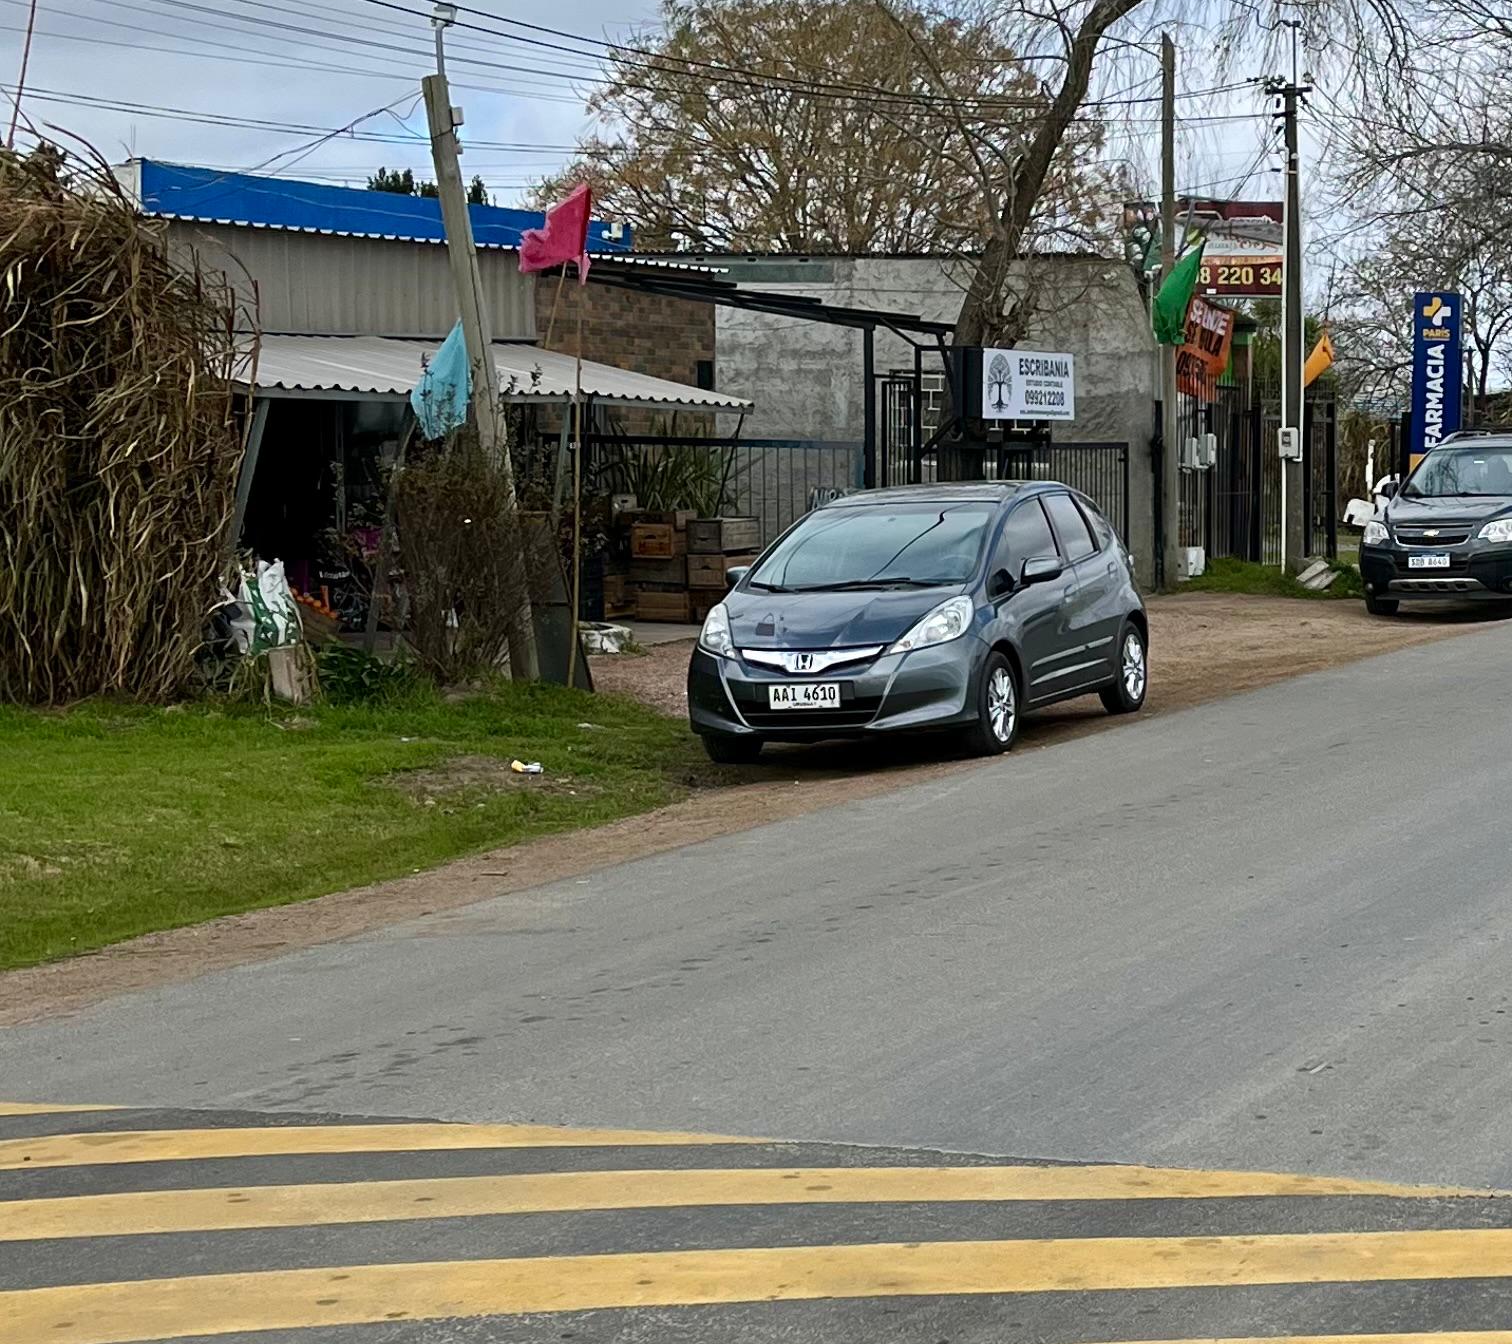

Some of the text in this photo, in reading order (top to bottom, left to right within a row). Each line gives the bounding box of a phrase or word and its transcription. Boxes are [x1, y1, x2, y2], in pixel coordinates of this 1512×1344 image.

[1217, 267, 1253, 285] 220
[1424, 344, 1445, 448] FARMACIA
[773, 686, 836, 702] AAI 4610
